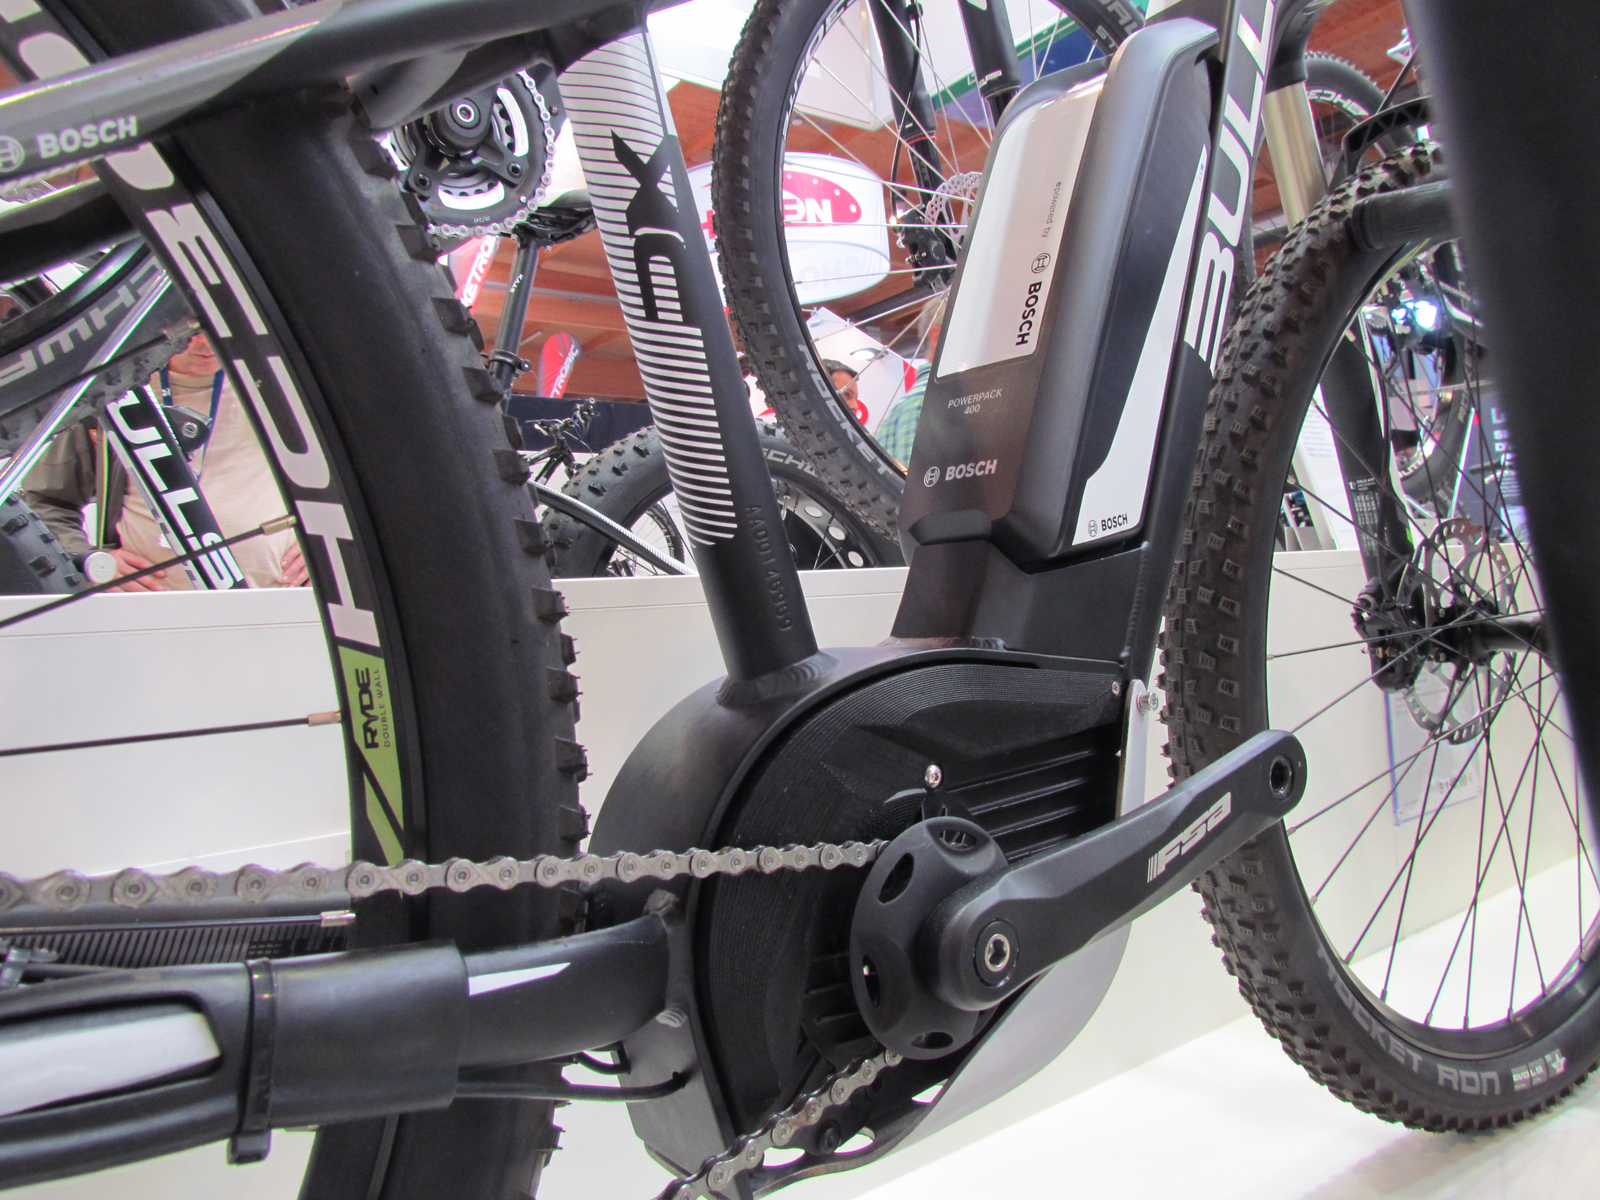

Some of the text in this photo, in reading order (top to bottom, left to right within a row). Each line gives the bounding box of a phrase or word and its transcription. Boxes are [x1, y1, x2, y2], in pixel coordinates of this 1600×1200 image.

[36, 115, 138, 159] BOSCH
[1041, 181, 1062, 238] epowered by
[1015, 281, 1043, 346] BOSCH
[947, 388, 1004, 409] POWERPACK
[963, 404, 981, 415] 400
[945, 459, 998, 481] BOSCH
[1101, 512, 1128, 531] BOSCH
[355, 667, 379, 749] RYDE
[373, 667, 391, 748] DOUBLE WALL
[1316, 945, 1501, 1096] ROCKET RON
